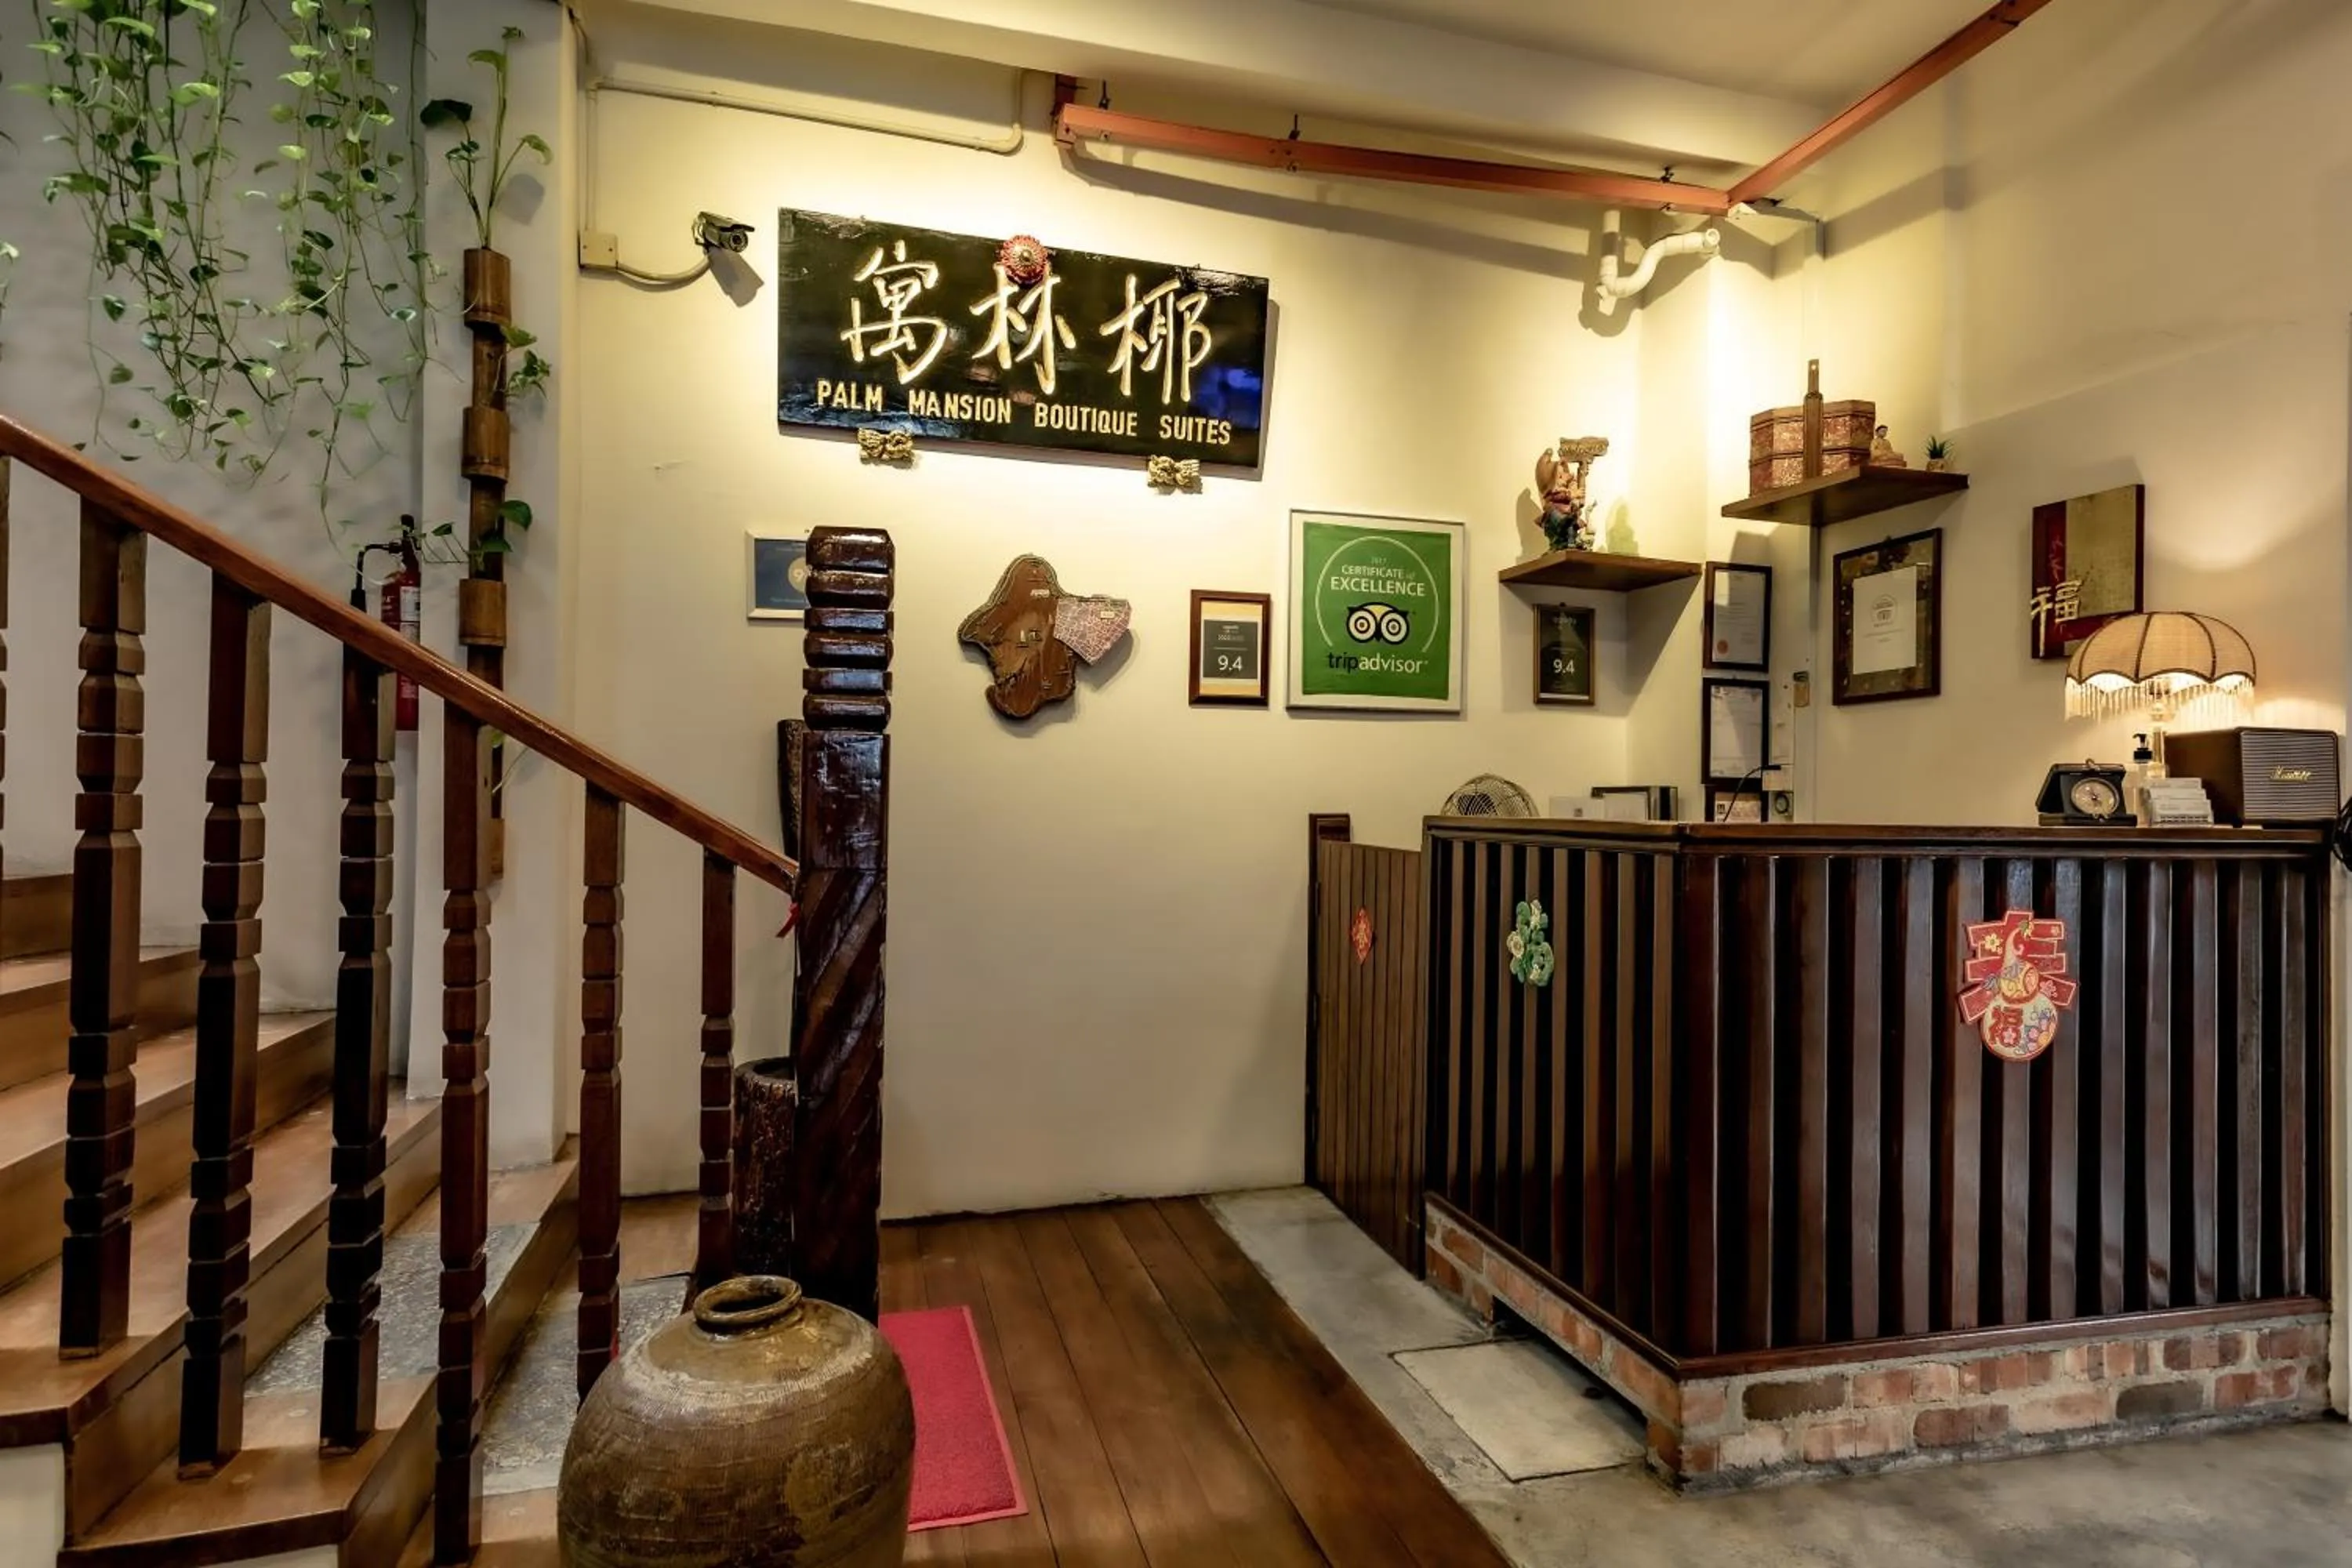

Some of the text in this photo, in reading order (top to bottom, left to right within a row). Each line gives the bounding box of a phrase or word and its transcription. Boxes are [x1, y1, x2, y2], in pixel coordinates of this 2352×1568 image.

[817, 379, 1232, 445] PALM MANSION BOUTIQUE SUITES
[1341, 564, 1403, 579] CERTIFICATE
[1330, 576, 1426, 597] EXCELLENCE
[1218, 655, 1243, 672] 9.4
[1328, 652, 1423, 674] tripadvisor
[1553, 659, 1575, 673] 9.4
